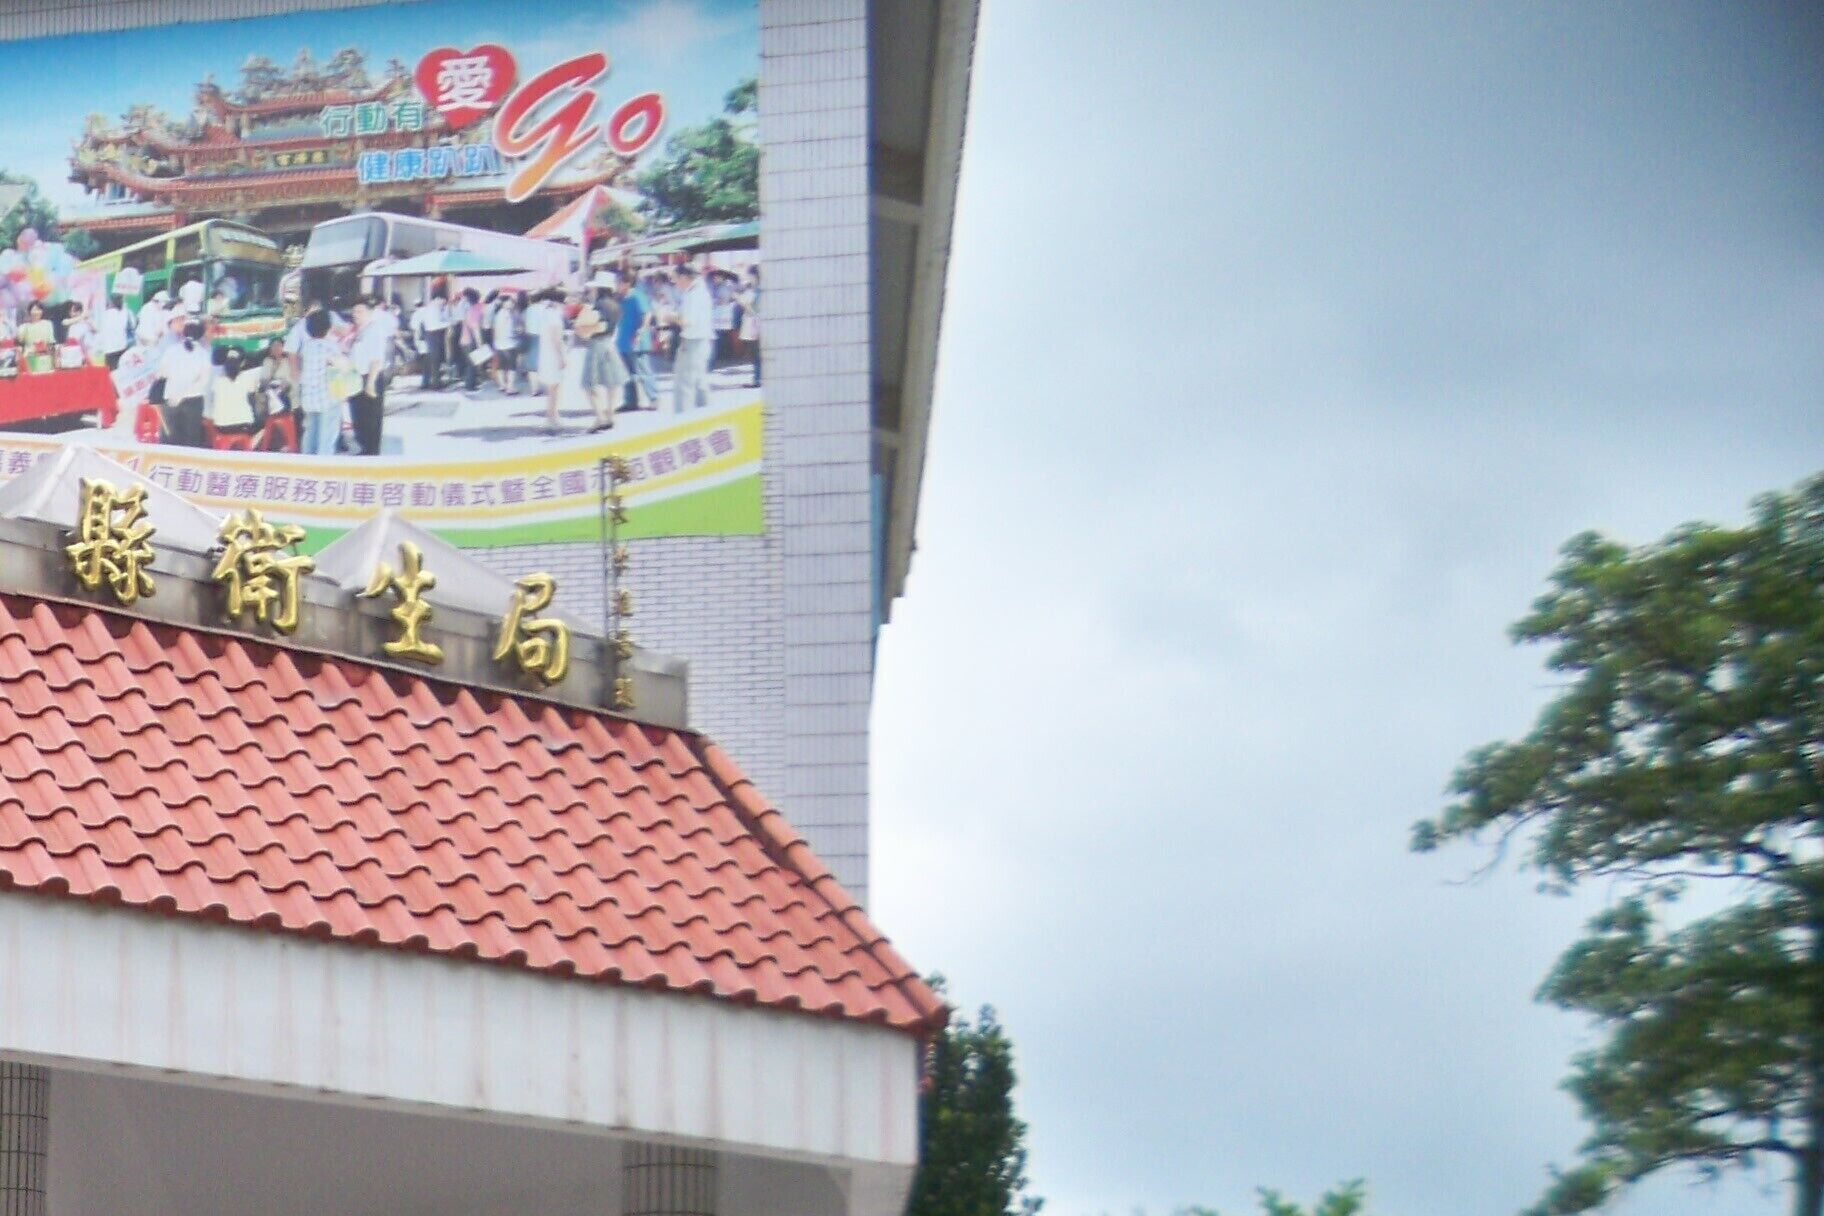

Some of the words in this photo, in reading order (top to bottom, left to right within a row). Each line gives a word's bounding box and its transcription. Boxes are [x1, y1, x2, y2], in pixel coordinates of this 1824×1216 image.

[319, 101, 424, 138] 行動有
[437, 54, 495, 113] 愛
[357, 143, 503, 184] 健康趴趴
